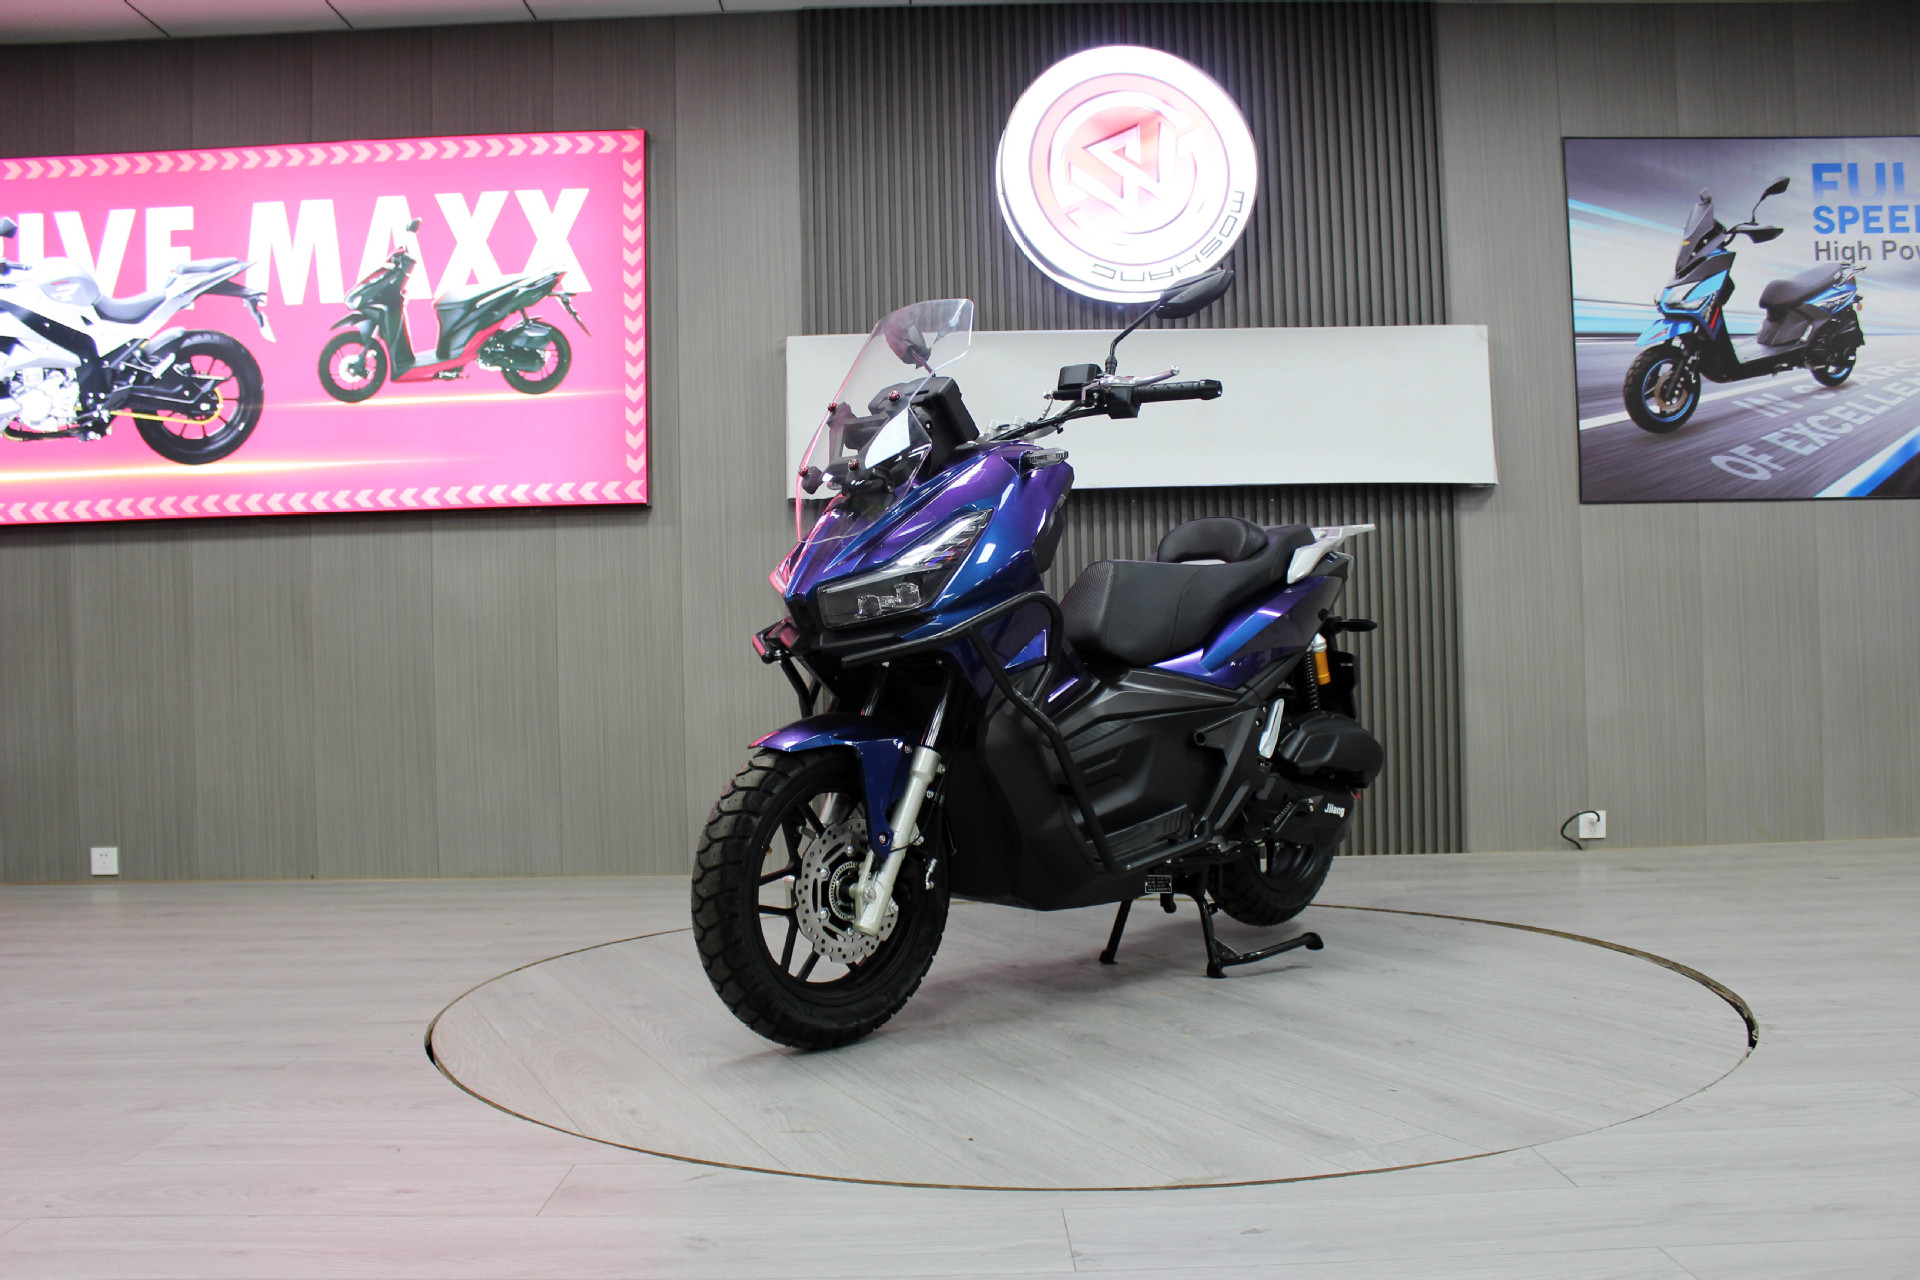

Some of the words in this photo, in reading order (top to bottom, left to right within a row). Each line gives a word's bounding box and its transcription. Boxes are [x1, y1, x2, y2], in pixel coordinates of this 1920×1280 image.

[245, 188, 592, 305] MAXX
[1814, 240, 1872, 264] High
[1732, 393, 1804, 418] IN
[1710, 444, 1785, 481] OF
[1324, 803, 1346, 818] Jilang
